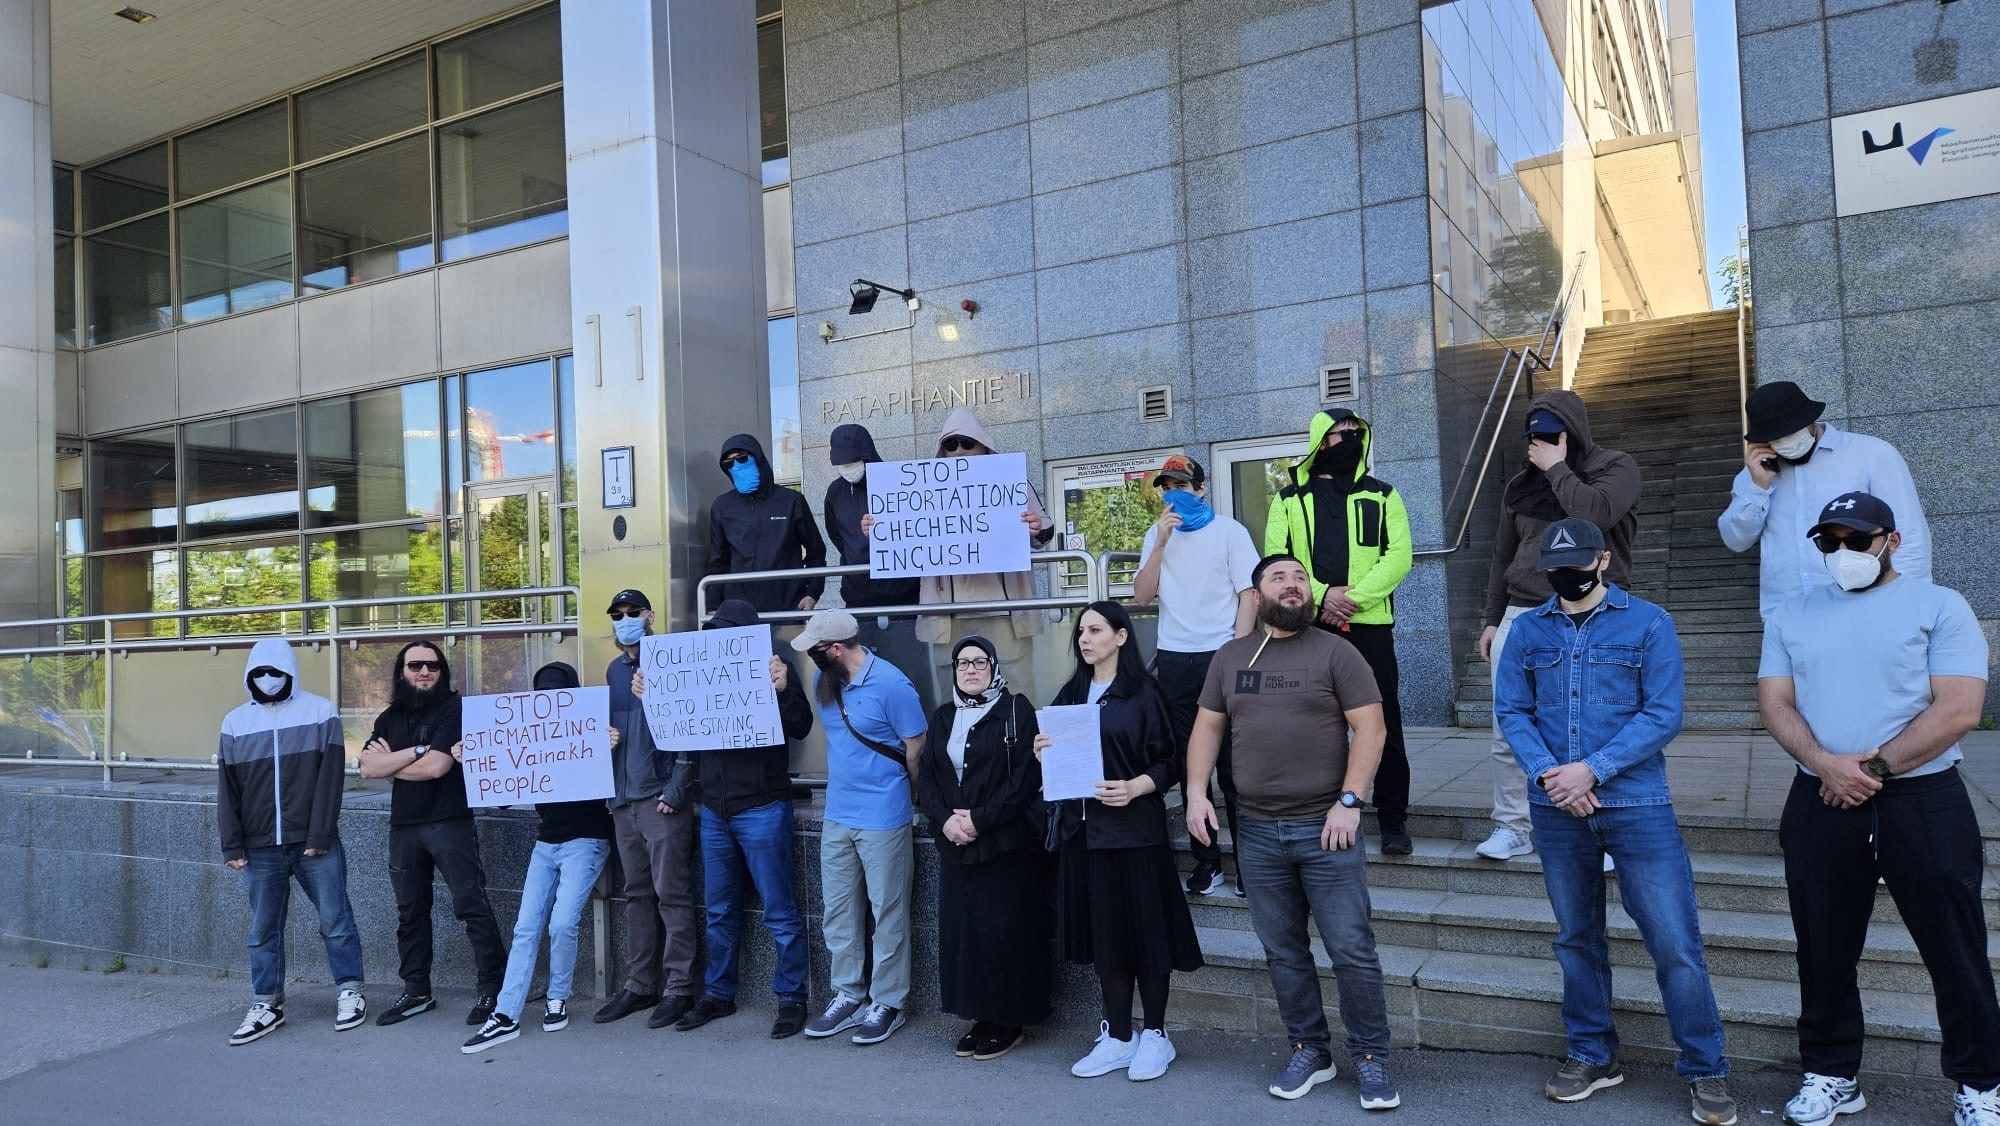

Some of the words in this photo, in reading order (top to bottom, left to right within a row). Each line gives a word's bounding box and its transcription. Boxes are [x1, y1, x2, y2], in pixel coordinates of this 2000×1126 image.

[585, 306, 644, 387] 11
[822, 376, 1004, 424] RATAPIHANTIE
[1016, 372, 1032, 400] 11
[608, 456, 625, 482] T
[901, 458, 969, 486] STOP
[871, 482, 1029, 514] DEPORTATIONS
[873, 512, 990, 541] CHECHENS
[876, 542, 980, 571] INGUSH
[687, 635, 708, 663] did
[718, 636, 755, 658] NOT
[1241, 675, 1254, 687] H
[1264, 681, 1300, 689] HUNTER
[495, 691, 574, 725] STOP
[649, 702, 671, 718] US
[675, 699, 695, 715] TO
[706, 684, 775, 711] LEAVE!
[652, 724, 669, 740] WE
[673, 719, 697, 737] ARE
[700, 715, 754, 736] STAYING
[722, 726, 776, 752] HERE!
[465, 755, 497, 773] THE
[507, 740, 593, 770] Vainakh
[479, 770, 553, 800] people
